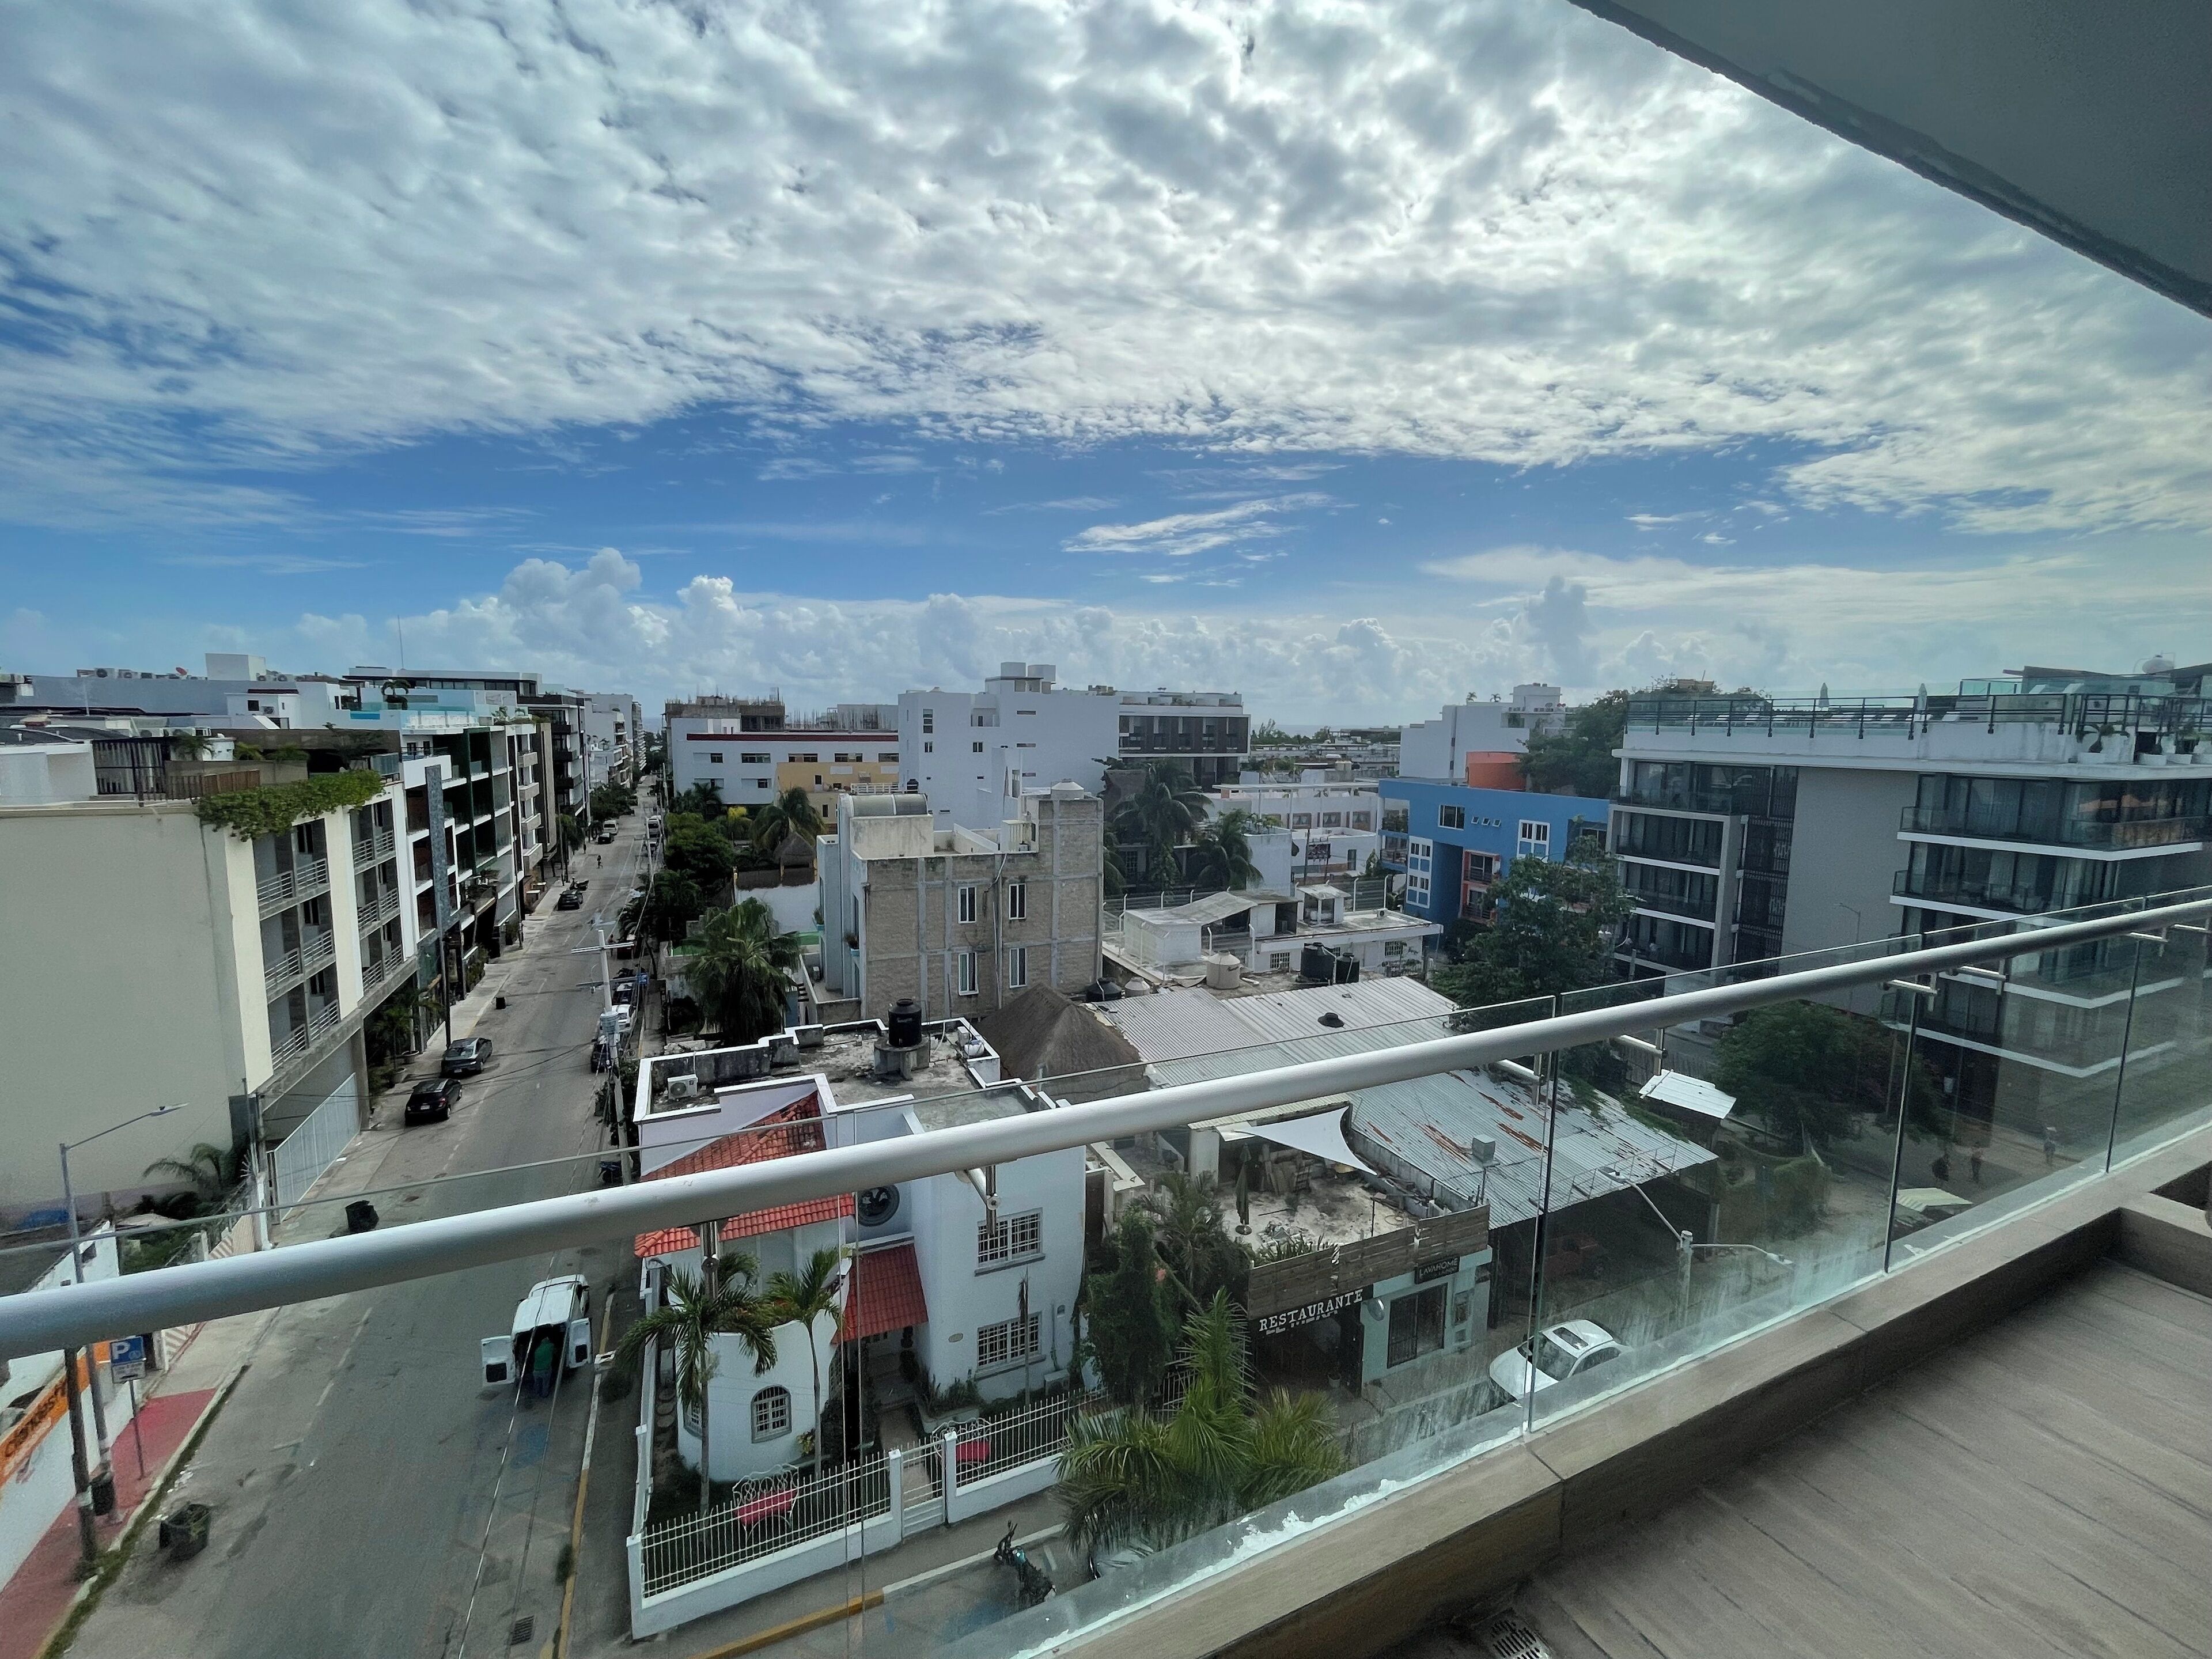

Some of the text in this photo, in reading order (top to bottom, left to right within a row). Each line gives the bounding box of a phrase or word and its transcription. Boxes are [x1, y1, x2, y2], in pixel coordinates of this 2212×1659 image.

[1419, 1257, 1458, 1278] LAVAHOME
[1259, 1289, 1363, 1331] RESTAURANTE
[112, 1342, 131, 1360] P
